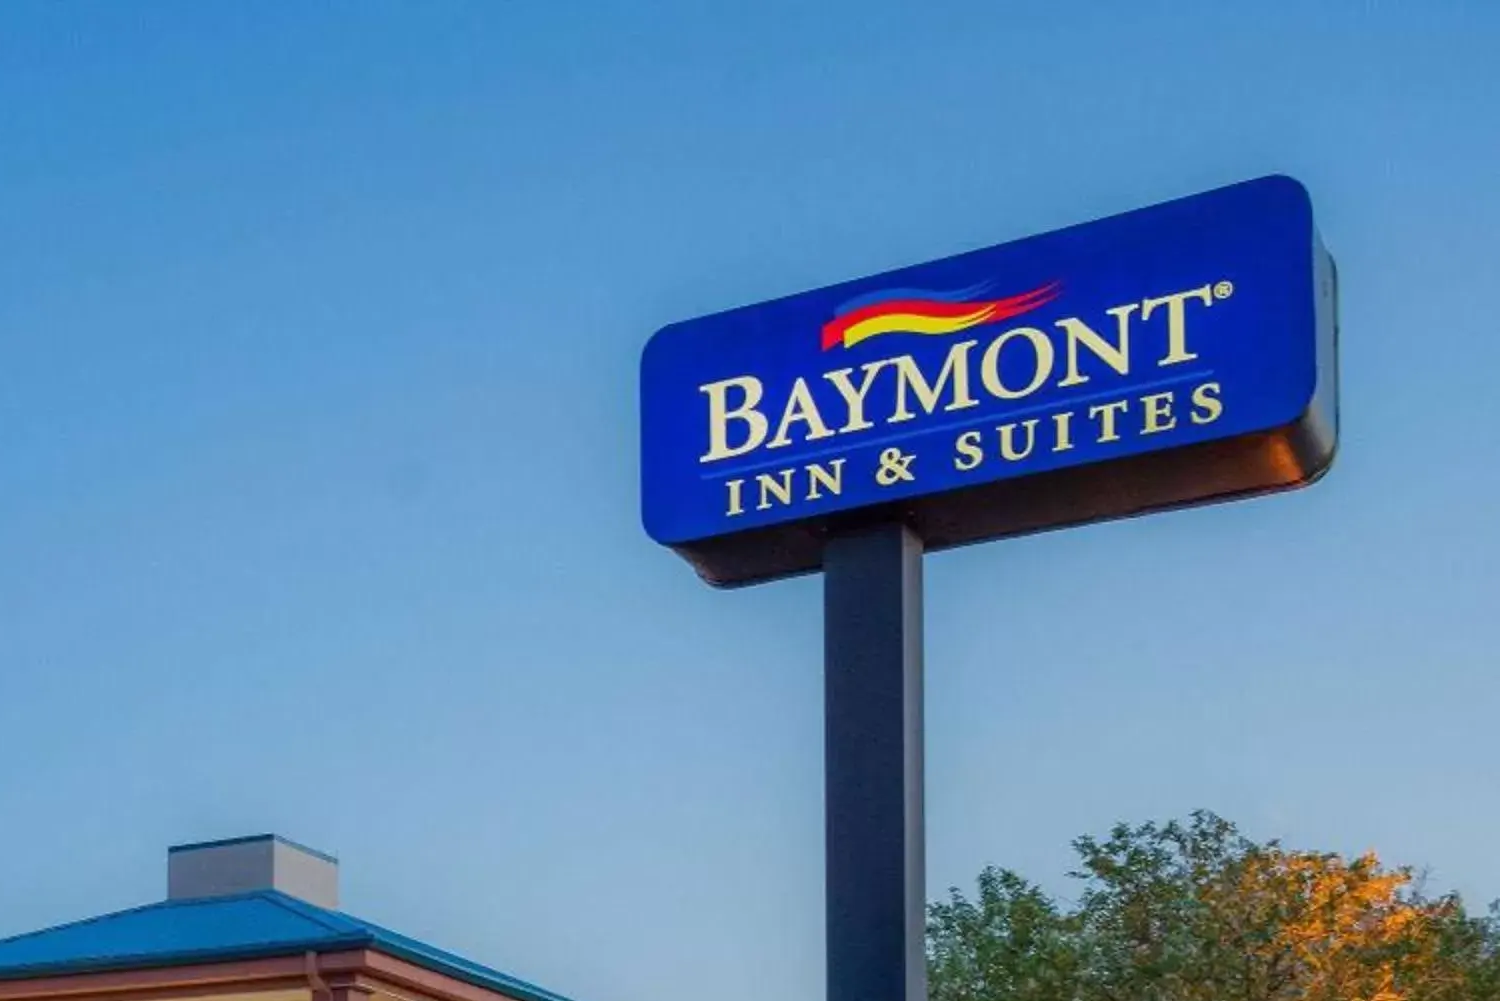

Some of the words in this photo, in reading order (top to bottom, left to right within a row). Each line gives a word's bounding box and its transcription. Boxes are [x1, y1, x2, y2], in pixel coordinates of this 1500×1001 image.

[726, 459, 845, 516] INN
[876, 447, 916, 486] &
[954, 382, 1224, 471] SUITES
